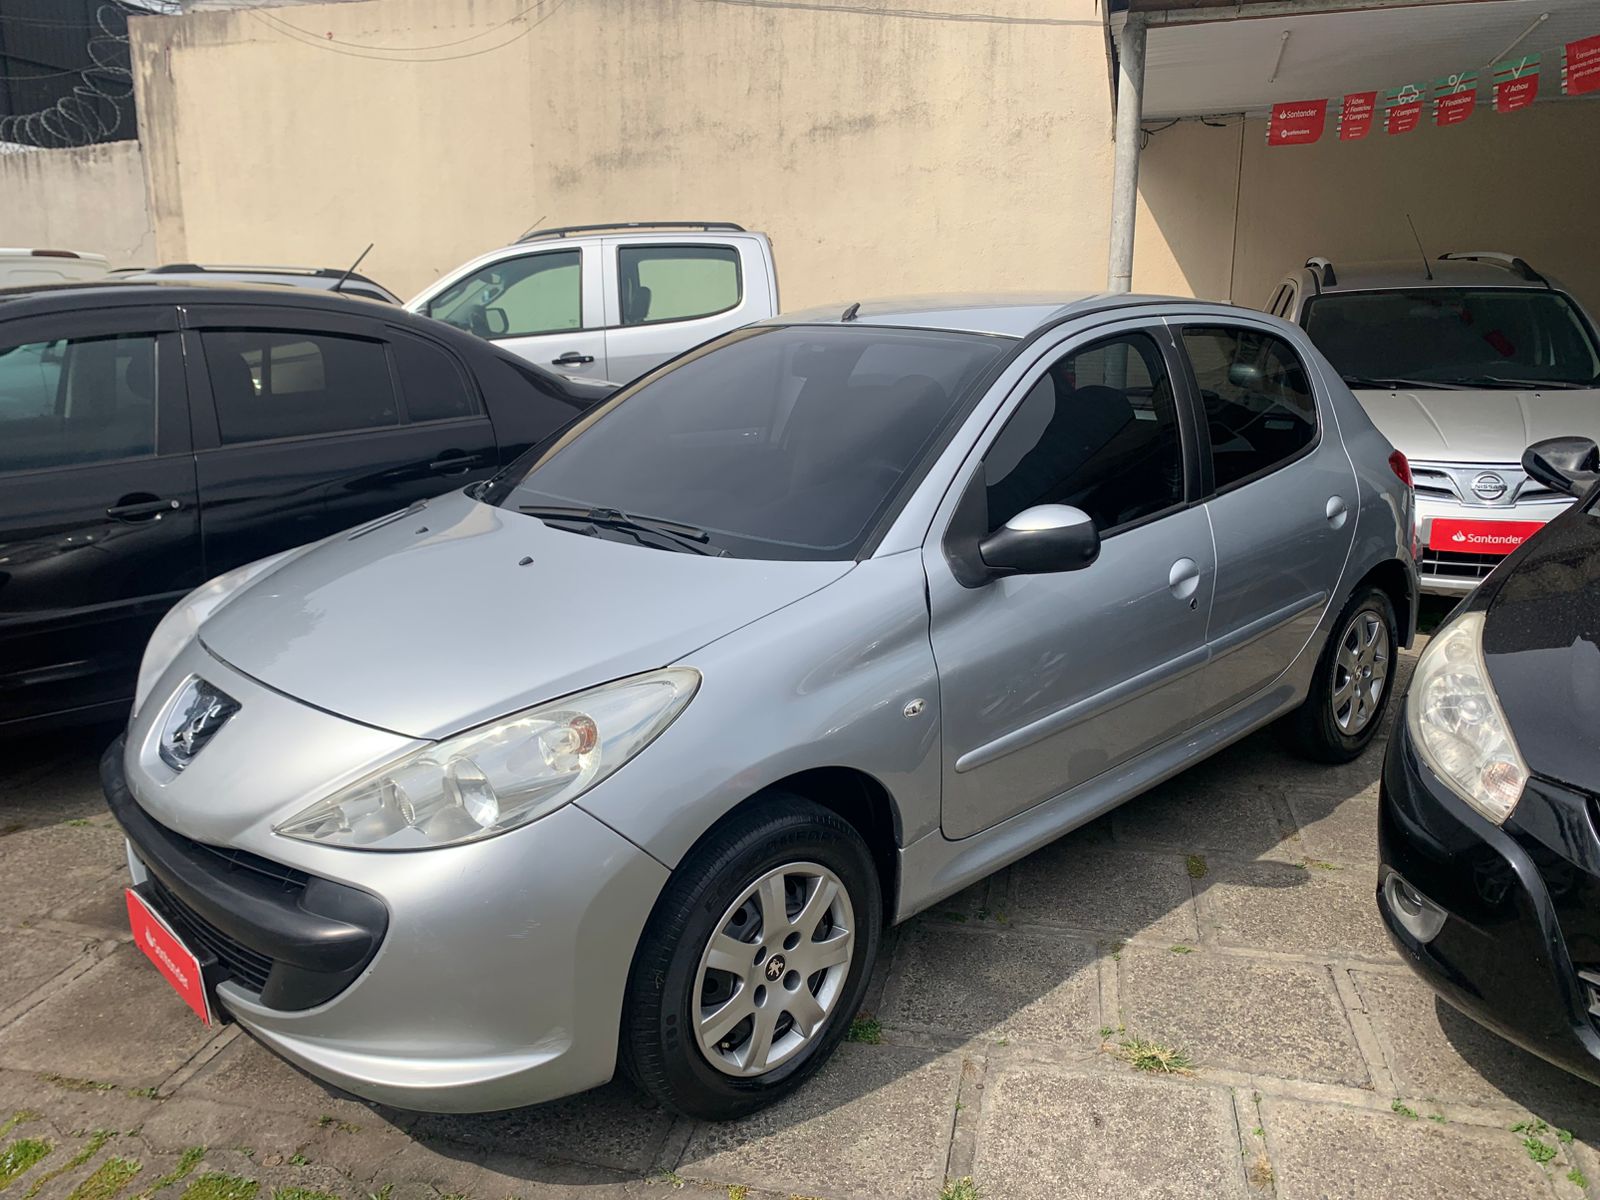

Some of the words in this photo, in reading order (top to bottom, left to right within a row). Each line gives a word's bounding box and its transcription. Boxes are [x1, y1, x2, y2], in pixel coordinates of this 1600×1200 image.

[1510, 83, 1529, 93] Achou
[1445, 96, 1472, 107] Financiou
[1286, 109, 1318, 119] Santander
[1397, 107, 1420, 117] Comprou
[1467, 533, 1522, 544] Santander
